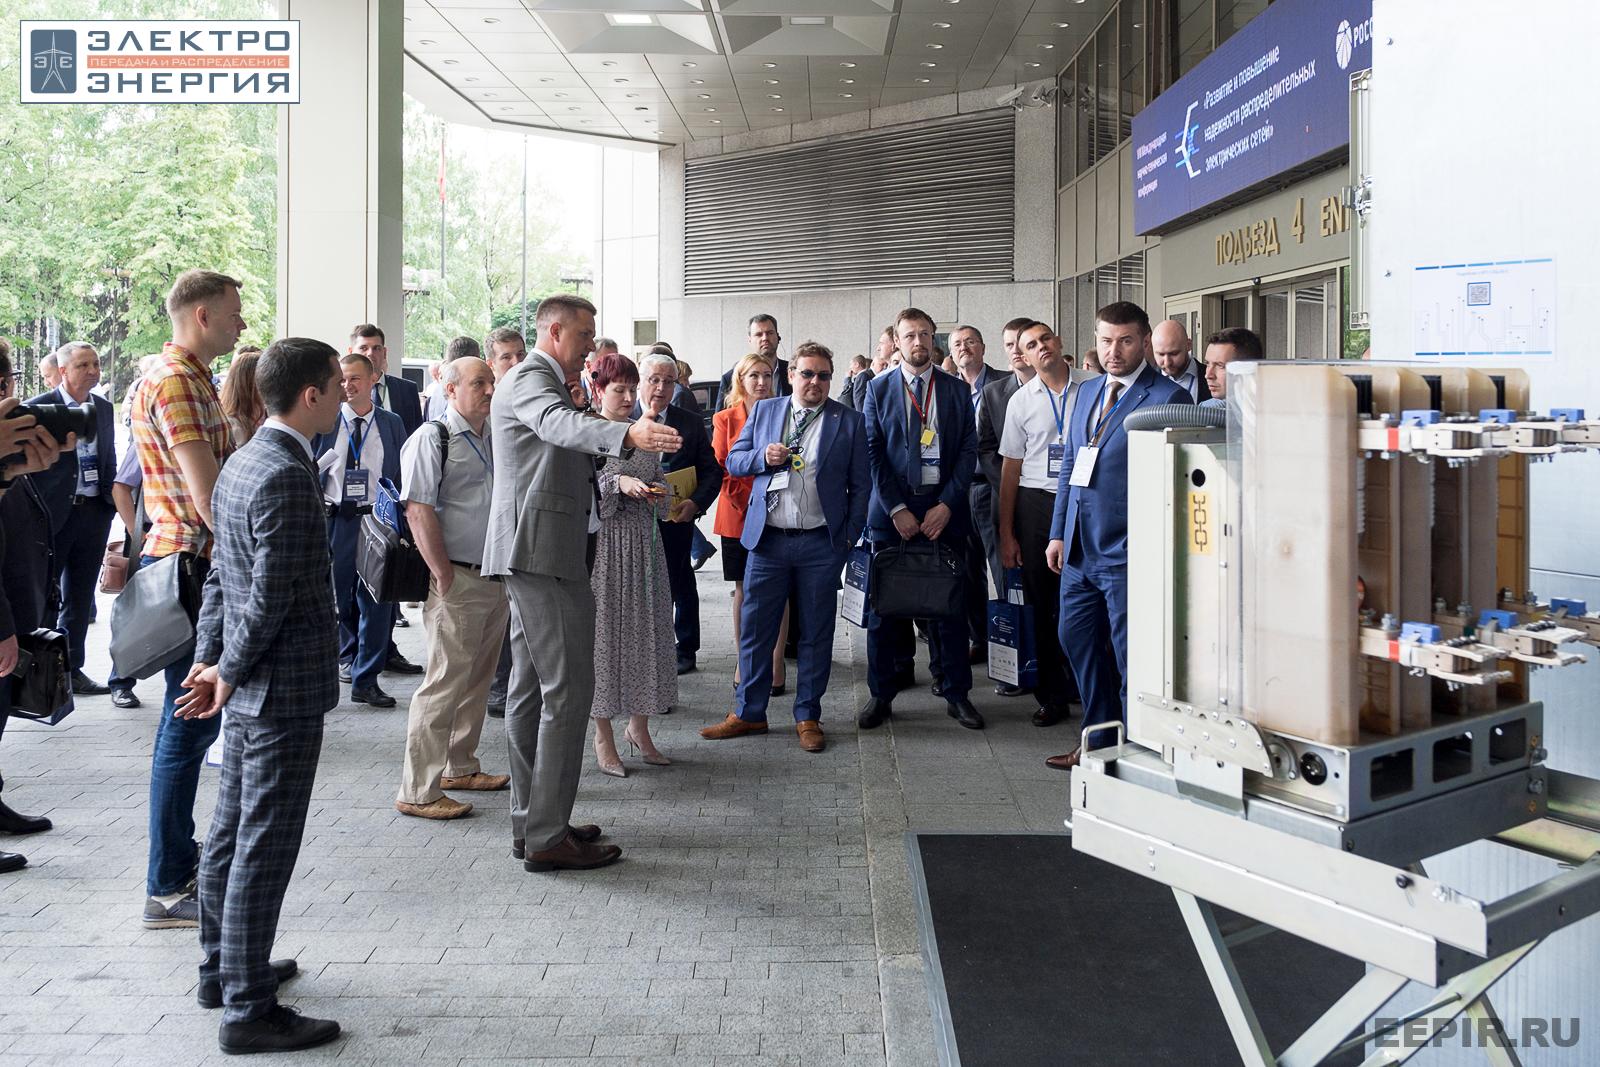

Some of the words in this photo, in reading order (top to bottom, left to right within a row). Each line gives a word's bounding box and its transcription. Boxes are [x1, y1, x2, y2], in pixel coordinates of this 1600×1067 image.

[1233, 75, 1239, 90] и
[1239, 45, 1280, 87] повышение
[1204, 107, 1240, 142] надежности
[1240, 58, 1316, 126] распределительных
[1205, 138, 1249, 172] электрических
[1250, 119, 1274, 149] сетей»
[1289, 197, 1305, 244] 4
